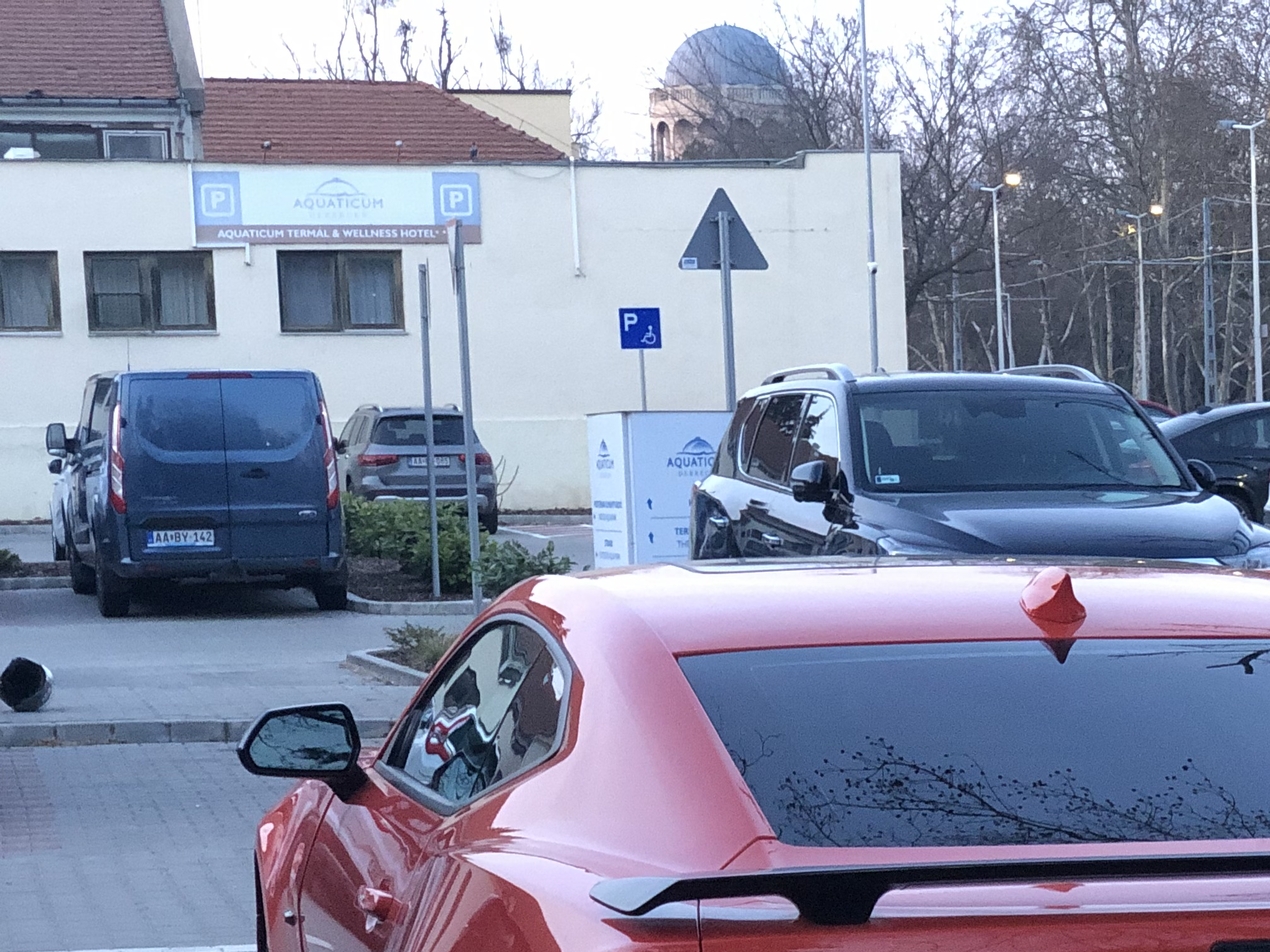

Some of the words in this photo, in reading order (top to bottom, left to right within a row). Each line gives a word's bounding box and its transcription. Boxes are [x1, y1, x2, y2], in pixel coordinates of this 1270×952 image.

[210, 190, 226, 210] P
[293, 198, 384, 210] AQUATICUM
[448, 190, 464, 210] P
[217, 228, 285, 239] AQUATICUM
[331, 229, 340, 238] &
[342, 228, 398, 238] WELLNESS
[624, 312, 638, 332] P
[666, 456, 714, 469] AQUATIC
